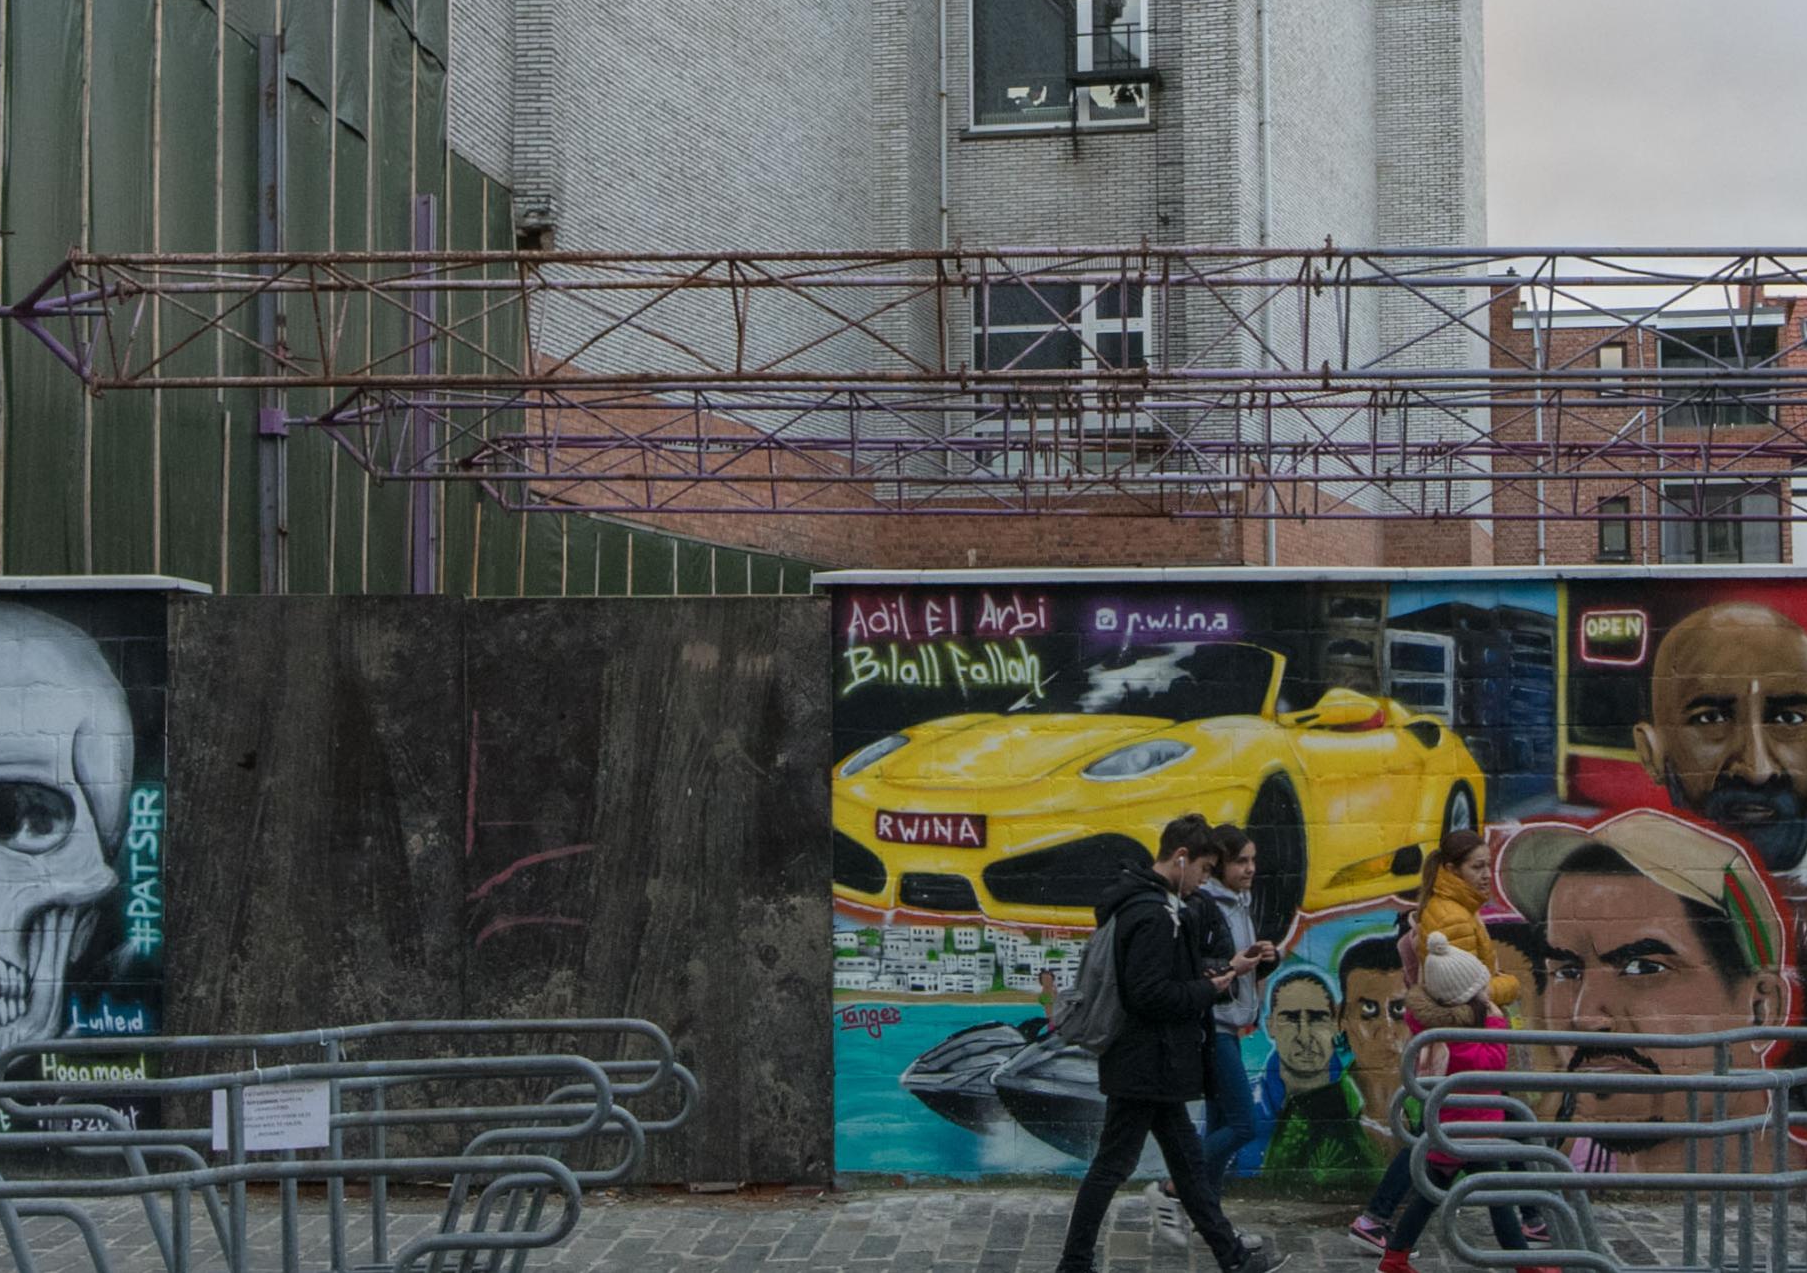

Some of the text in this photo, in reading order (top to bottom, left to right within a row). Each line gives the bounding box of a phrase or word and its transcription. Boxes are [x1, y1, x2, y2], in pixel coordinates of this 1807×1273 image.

[848, 593, 1046, 640] Adil El Arbi
[1585, 616, 1642, 638] OPEN
[843, 637, 1045, 699] Bilall Fallah
[877, 813, 981, 846] RWINA
[127, 788, 165, 956] #PATSER
